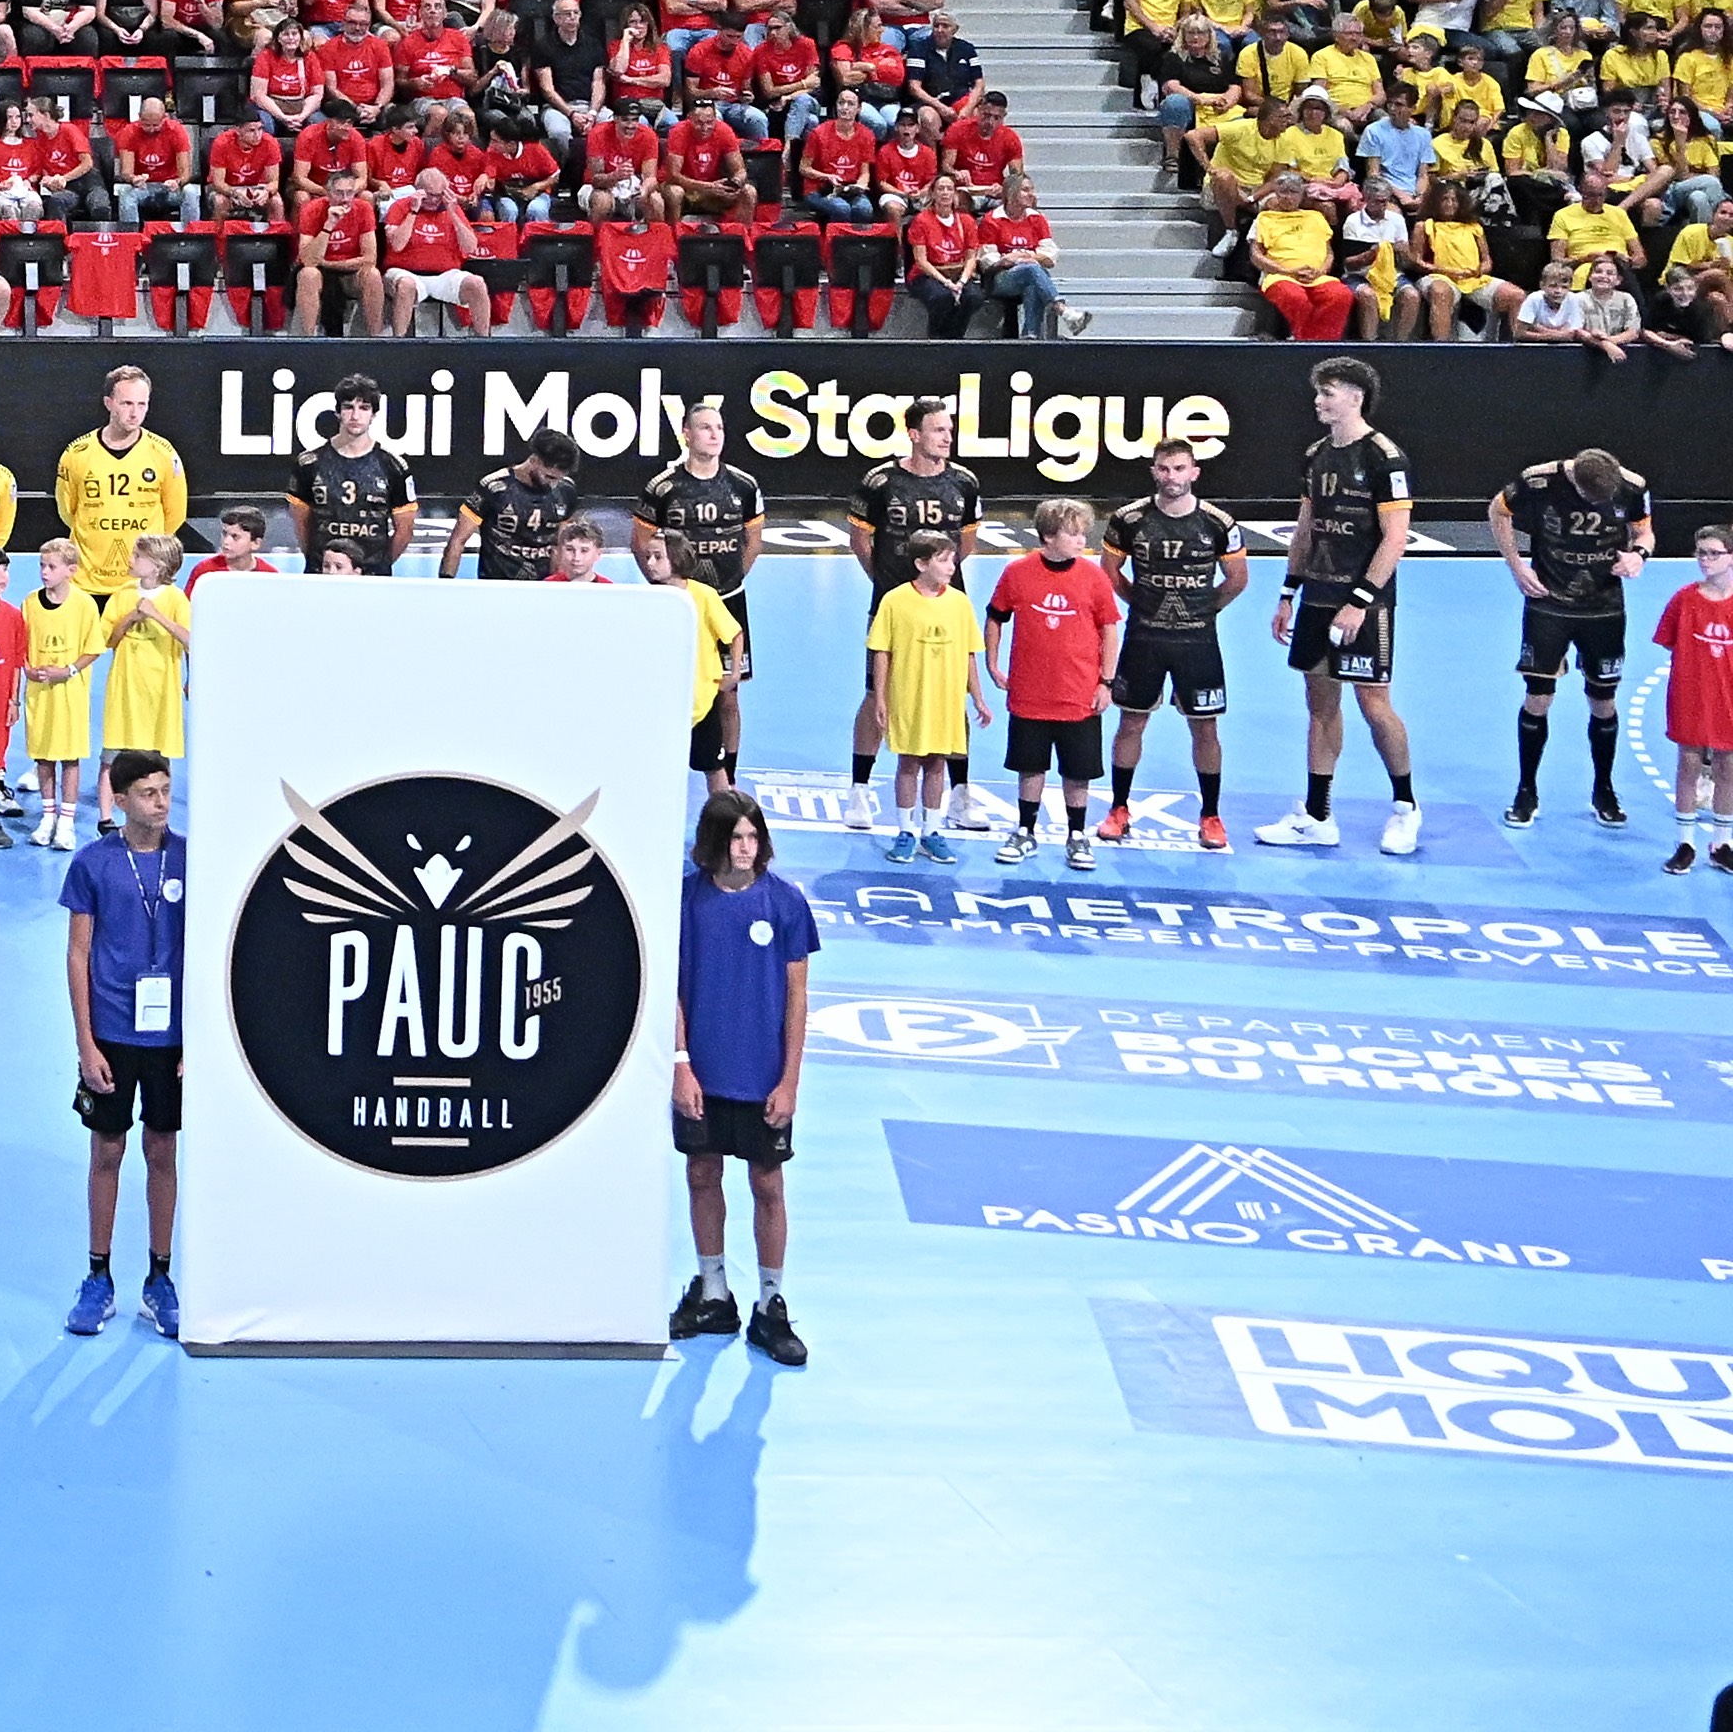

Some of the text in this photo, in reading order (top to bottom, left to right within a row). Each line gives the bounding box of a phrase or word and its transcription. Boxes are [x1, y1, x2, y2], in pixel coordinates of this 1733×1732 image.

[109, 474, 130, 496] 12
[341, 481, 356, 505] 3
[526, 509, 541, 532] 4
[695, 503, 717, 524] 10
[915, 500, 941, 525] 15
[1570, 512, 1602, 535] 22
[99, 518, 149, 531] CEPAC
[328, 523, 380, 537] CEPAC
[1162, 540, 1184, 559] 17
[1151, 575, 1207, 588] CEPAC
[1351, 657, 1373, 670] AIX
[327, 924, 542, 1060] PAUC
[524, 977, 563, 1012] 1955
[1098, 1008, 1627, 1056] DÉPARTEMENT
[352, 1095, 514, 1129] HANDBALL
[982, 1204, 1571, 1267] PASINO GRAND
[1246, 1324, 1733, 1402] LIQU
